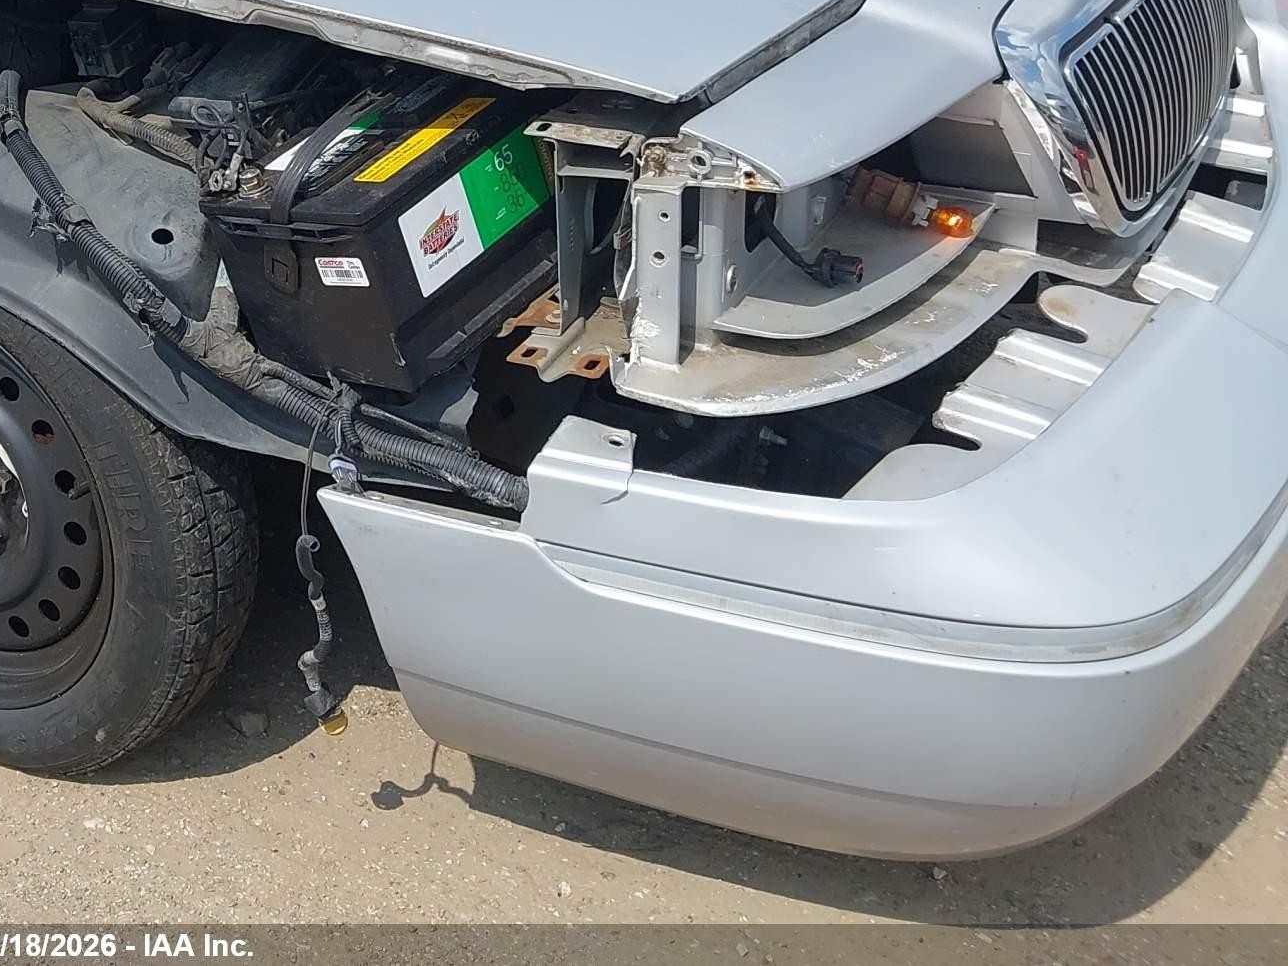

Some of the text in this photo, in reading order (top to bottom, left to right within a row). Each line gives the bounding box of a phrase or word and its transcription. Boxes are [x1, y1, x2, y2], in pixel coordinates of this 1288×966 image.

[494, 144, 513, 171] 65
[419, 211, 460, 250] INTERSTATE
[423, 224, 458, 256] BATTERIES
